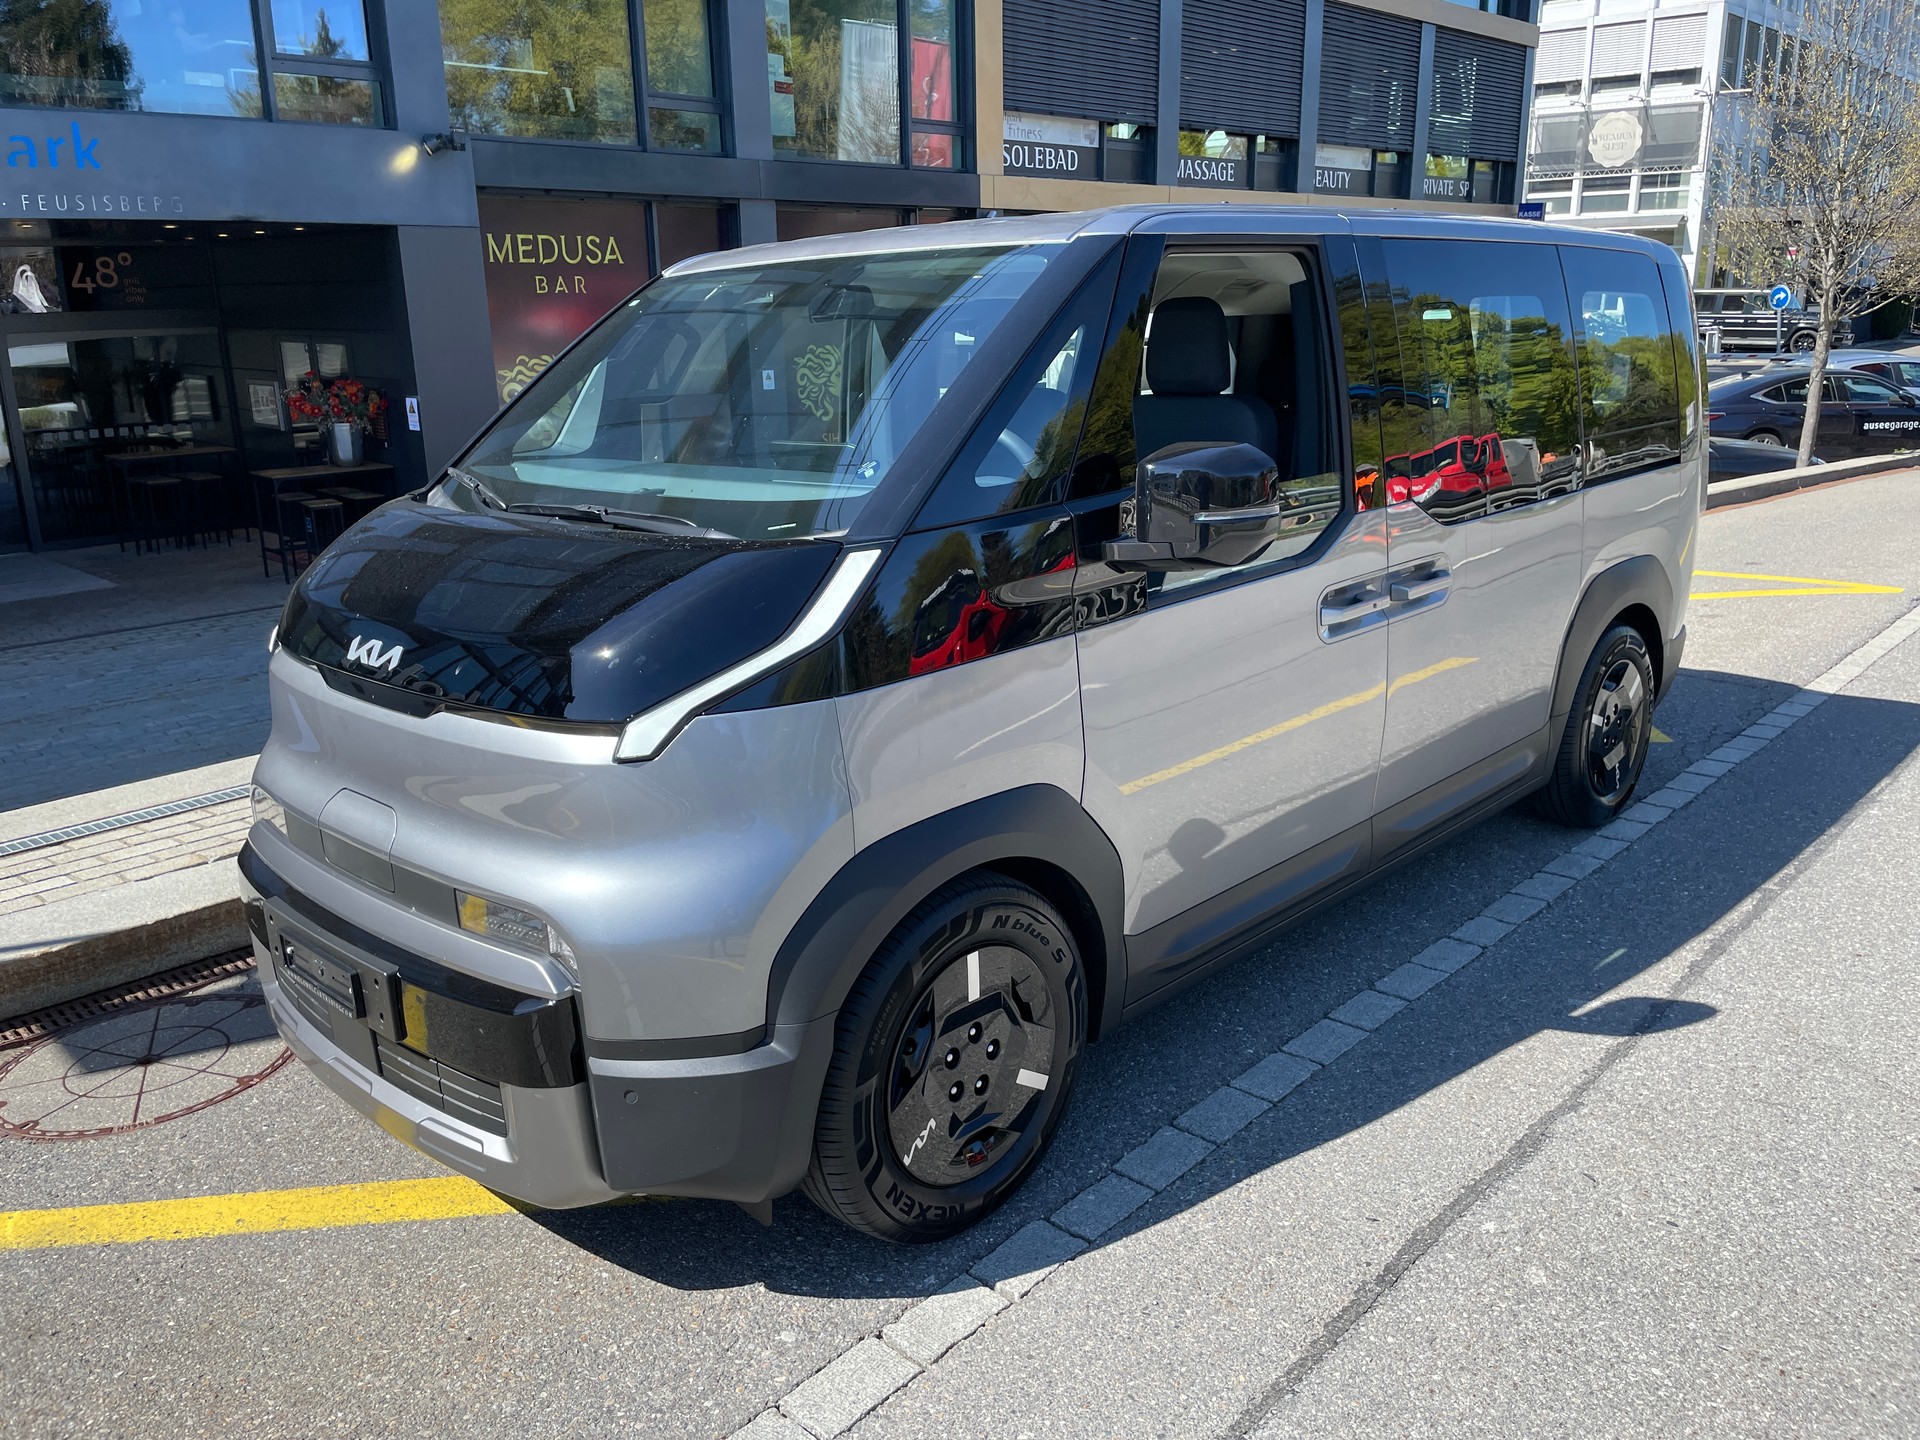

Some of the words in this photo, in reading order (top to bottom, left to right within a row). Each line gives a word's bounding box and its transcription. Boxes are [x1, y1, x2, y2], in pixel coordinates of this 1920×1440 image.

[1008, 123, 1042, 140] fitness
[1003, 144, 1078, 171] SOLEBAD
[1313, 169, 1351, 189] EAUTY
[21, 194, 183, 213] FEUSISBERG
[486, 233, 625, 265] MEDUSA
[534, 275, 587, 294] BAR
[126, 295, 145, 303] only
[1011, 918, 1050, 946] blue
[1051, 947, 1067, 964] S
[885, 1181, 966, 1222] NEXEN
